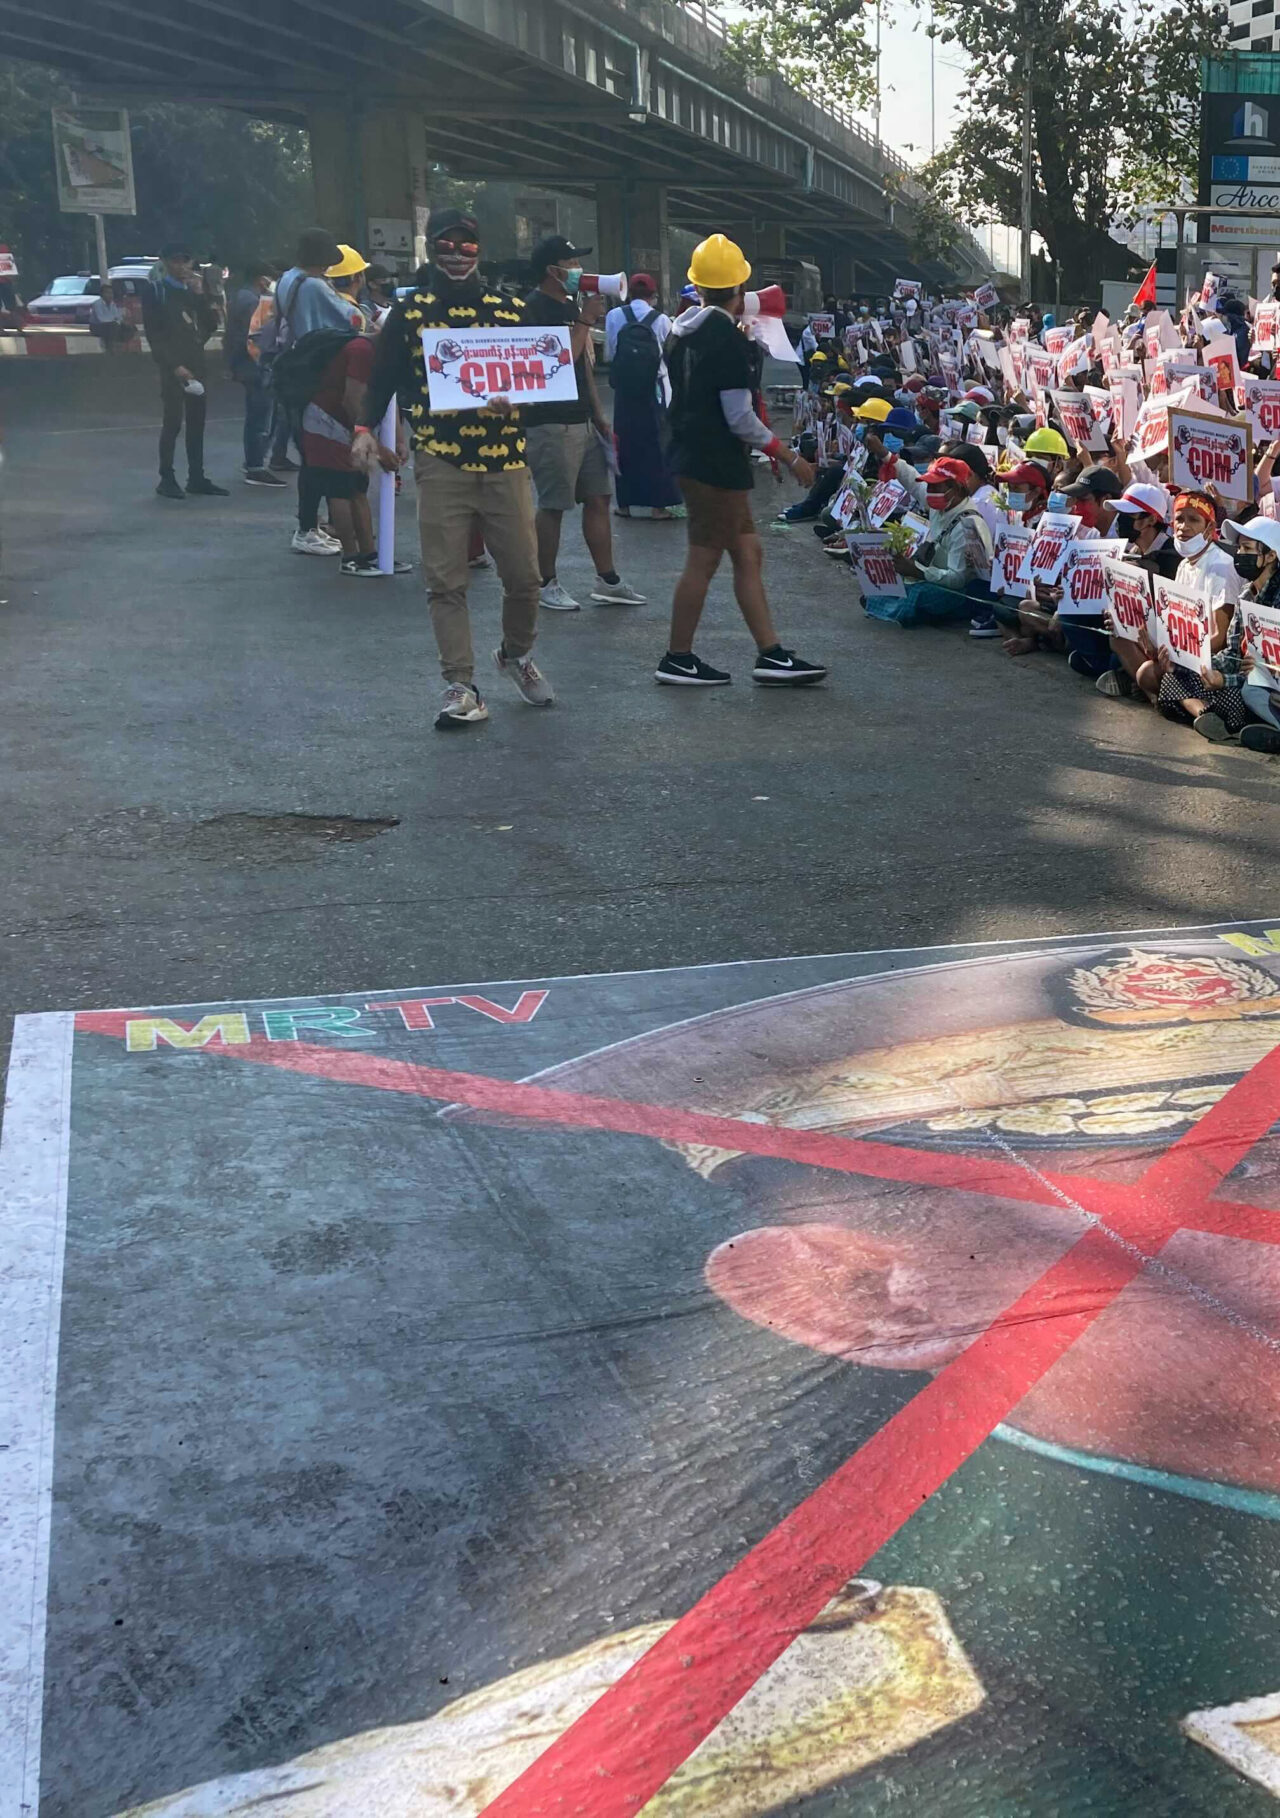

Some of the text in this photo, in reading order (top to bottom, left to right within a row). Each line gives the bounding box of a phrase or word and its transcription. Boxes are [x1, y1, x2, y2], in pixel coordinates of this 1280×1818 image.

[1216, 186, 1279, 208] Arcc
[811, 321, 830, 333] CDM
[460, 360, 546, 394] CDM
[1188, 446, 1232, 484] CDM
[1031, 539, 1062, 570] CDM
[1071, 569, 1103, 600] CDM
[1113, 590, 1145, 628] CDM
[1168, 613, 1201, 658] CDM
[126, 989, 551, 1052] MRTV
